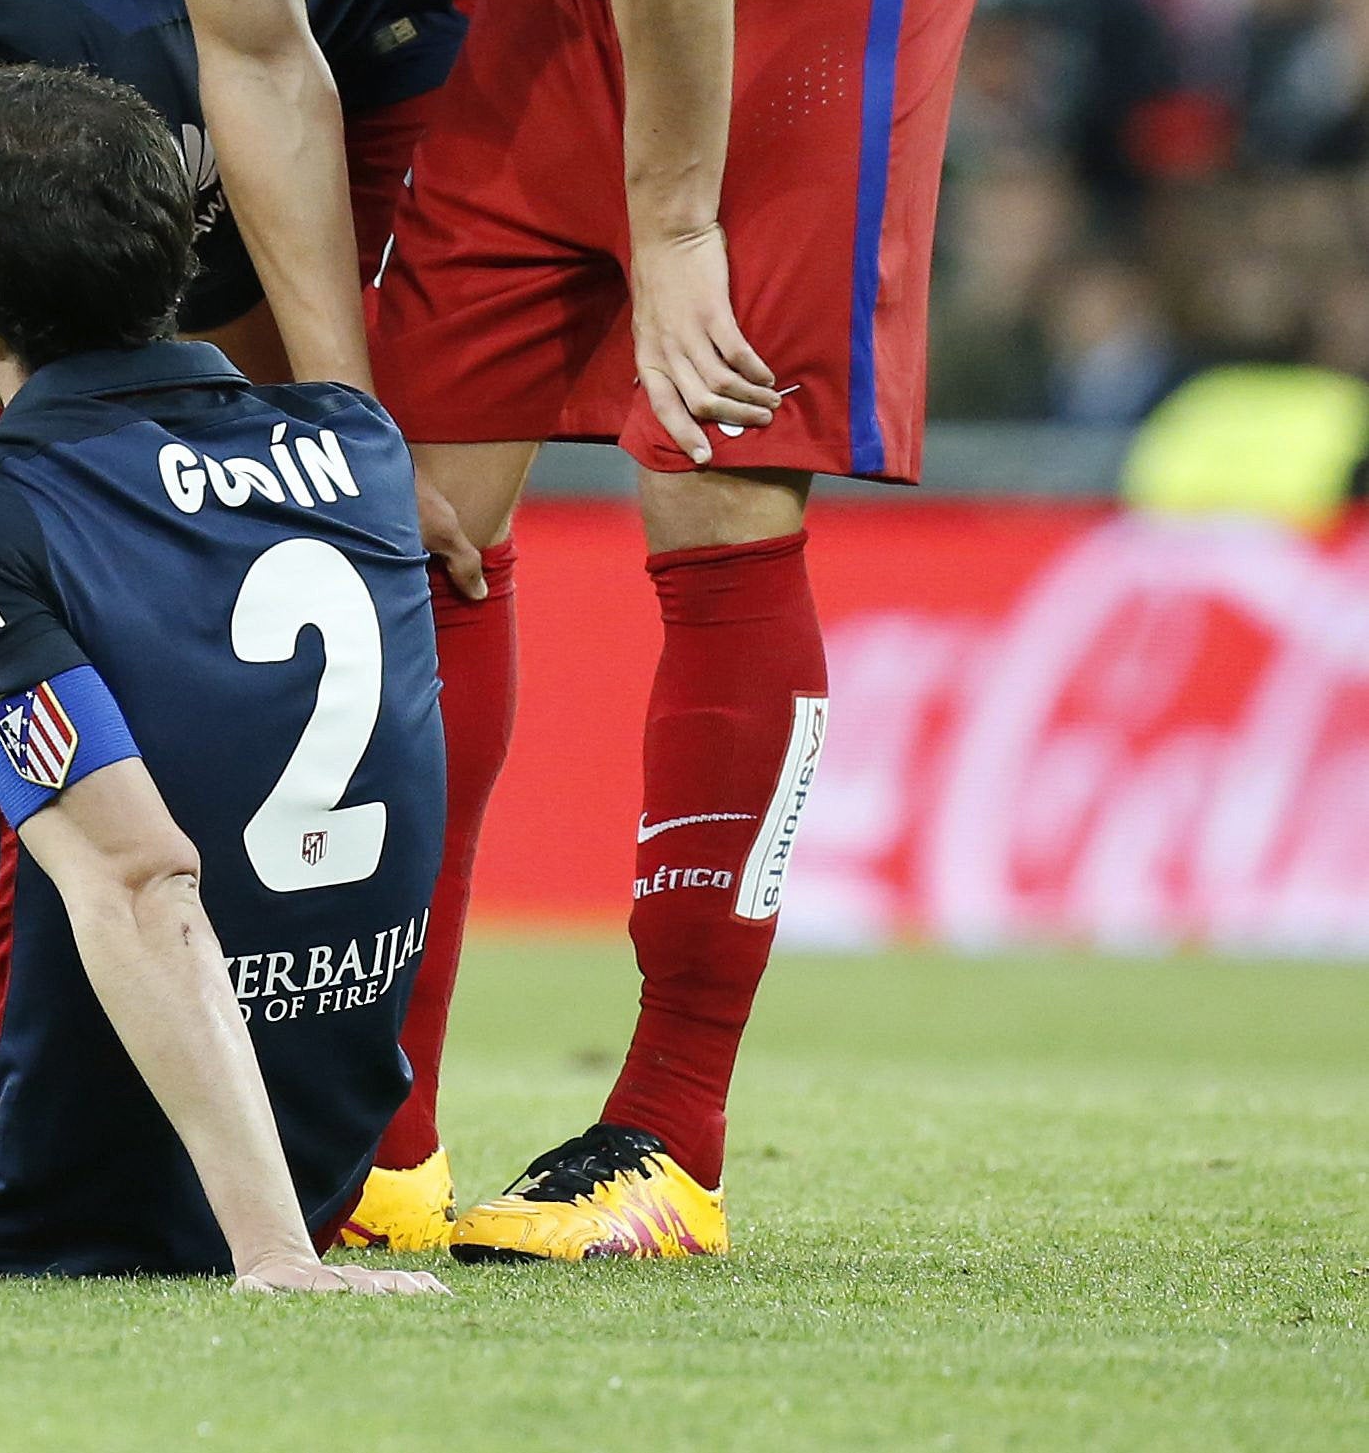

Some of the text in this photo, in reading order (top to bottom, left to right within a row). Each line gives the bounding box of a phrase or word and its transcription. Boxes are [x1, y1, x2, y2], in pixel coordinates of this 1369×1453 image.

[230, 537, 387, 893] 2
[763, 765, 814, 907] SPORTS
[633, 865, 733, 900] TLÉTICO
[264, 996, 306, 1022] OF
[316, 981, 379, 1015] FIRE
